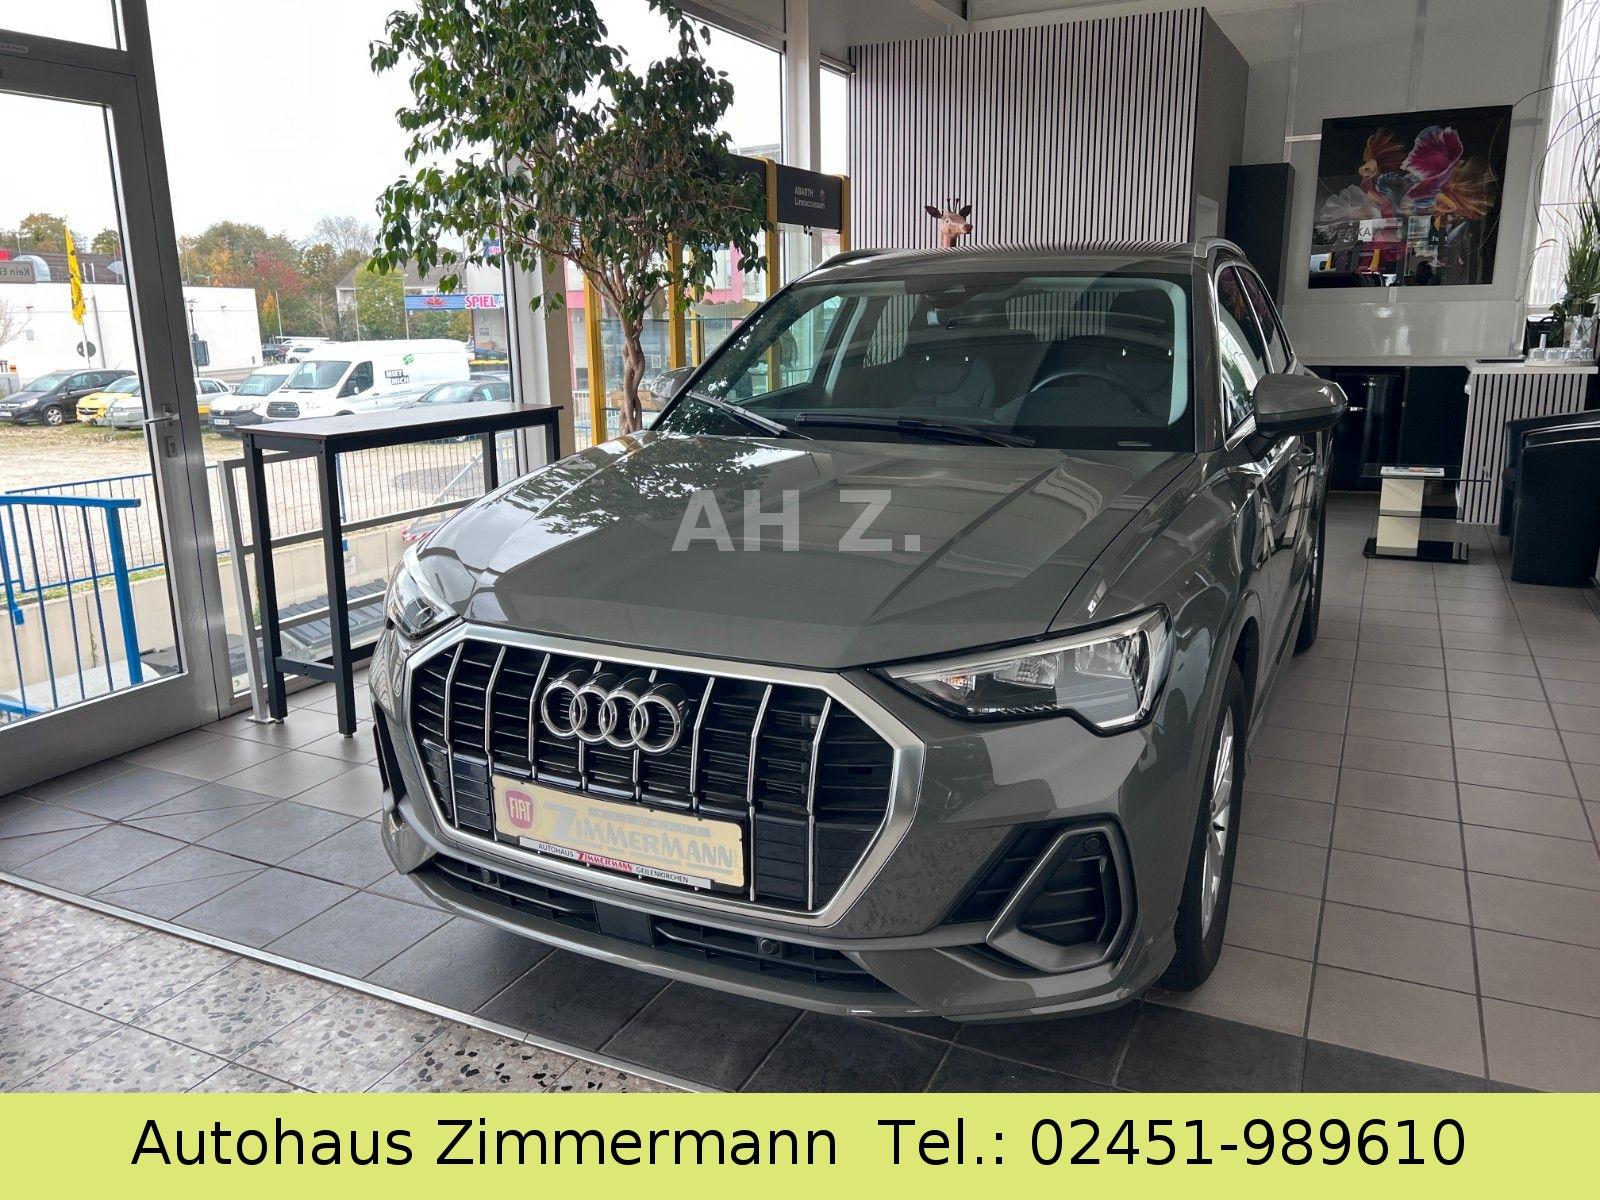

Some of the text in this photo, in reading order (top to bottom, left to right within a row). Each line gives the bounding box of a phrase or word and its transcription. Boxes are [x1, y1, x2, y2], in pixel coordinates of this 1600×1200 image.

[465, 294, 497, 309] SPIEL
[509, 796, 532, 822] FIAT
[542, 802, 733, 869] ZIMMERMANN
[538, 843, 689, 883] AUTOHAUS ZIMMERMANN GEILENKIRCHEN
